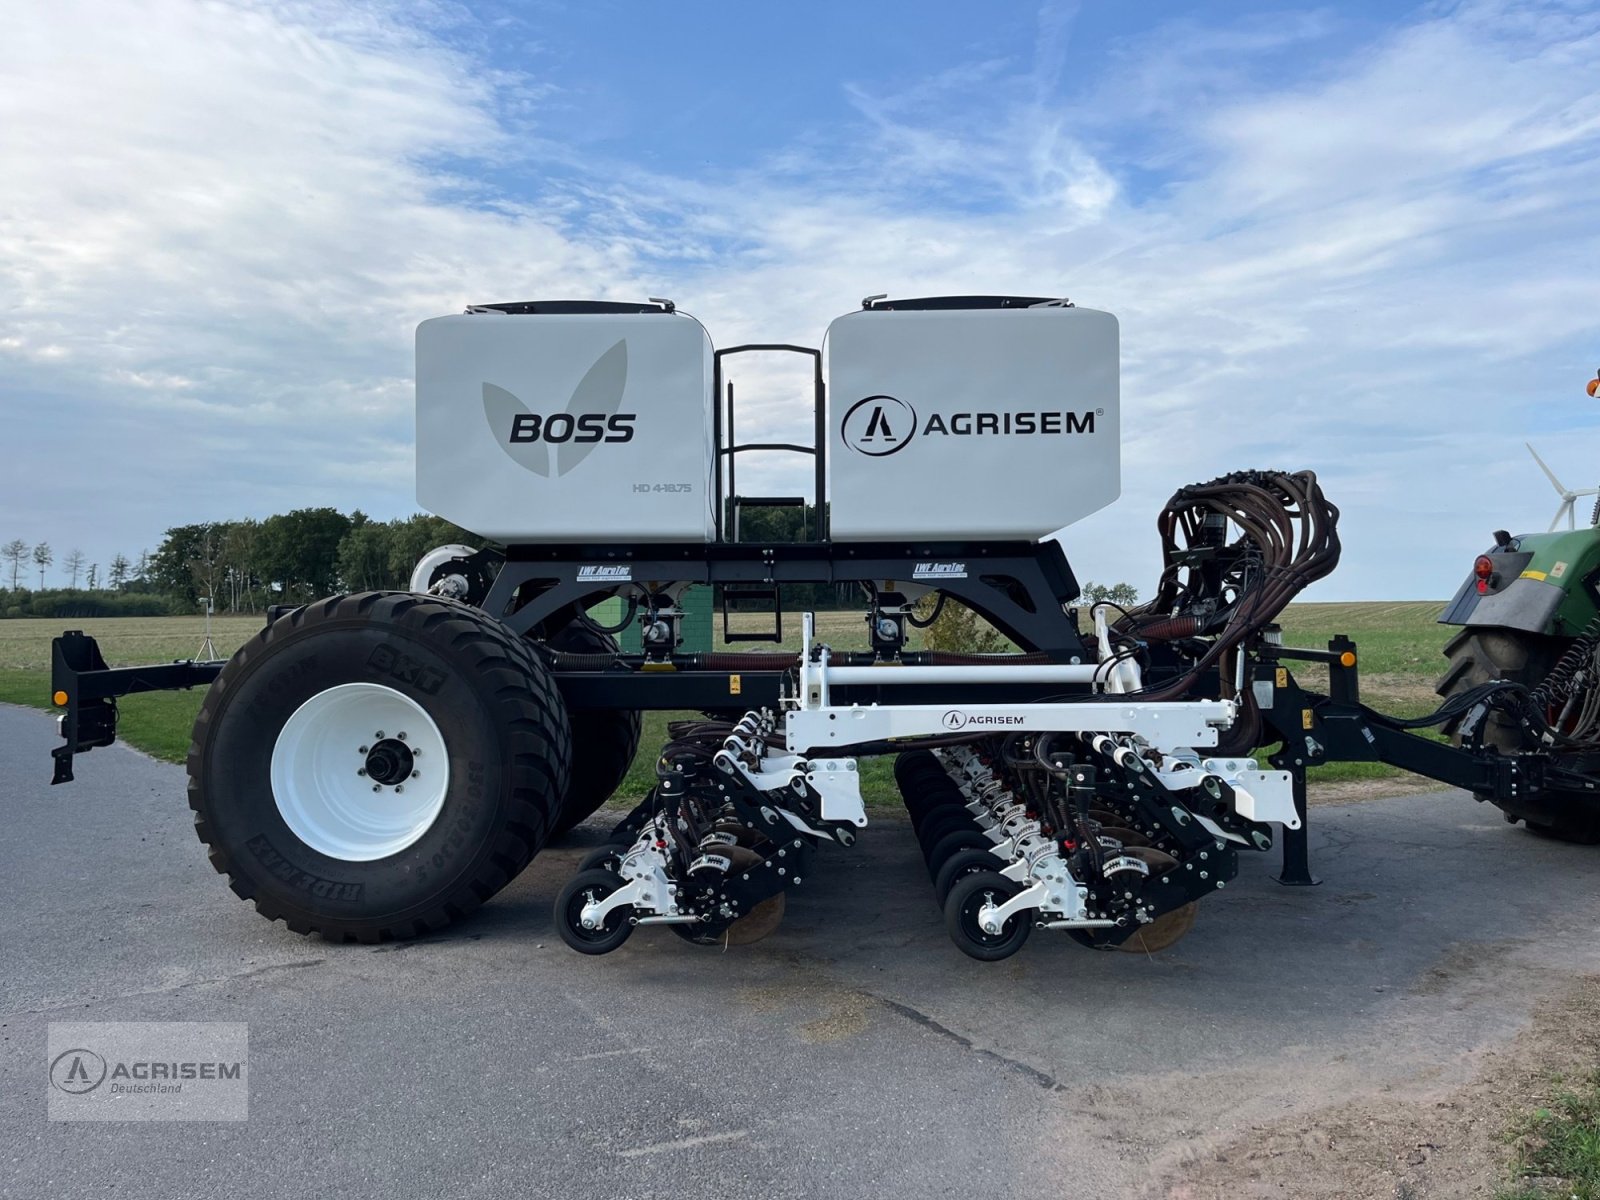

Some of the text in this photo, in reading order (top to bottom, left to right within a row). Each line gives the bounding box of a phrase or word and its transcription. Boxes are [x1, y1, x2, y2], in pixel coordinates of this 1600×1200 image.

[509, 413, 637, 444] BOSS
[922, 411, 1095, 436] AGRISEM
[633, 484, 650, 493] HD
[370, 644, 446, 694] BKT
[968, 716, 1024, 724] AGRISEM
